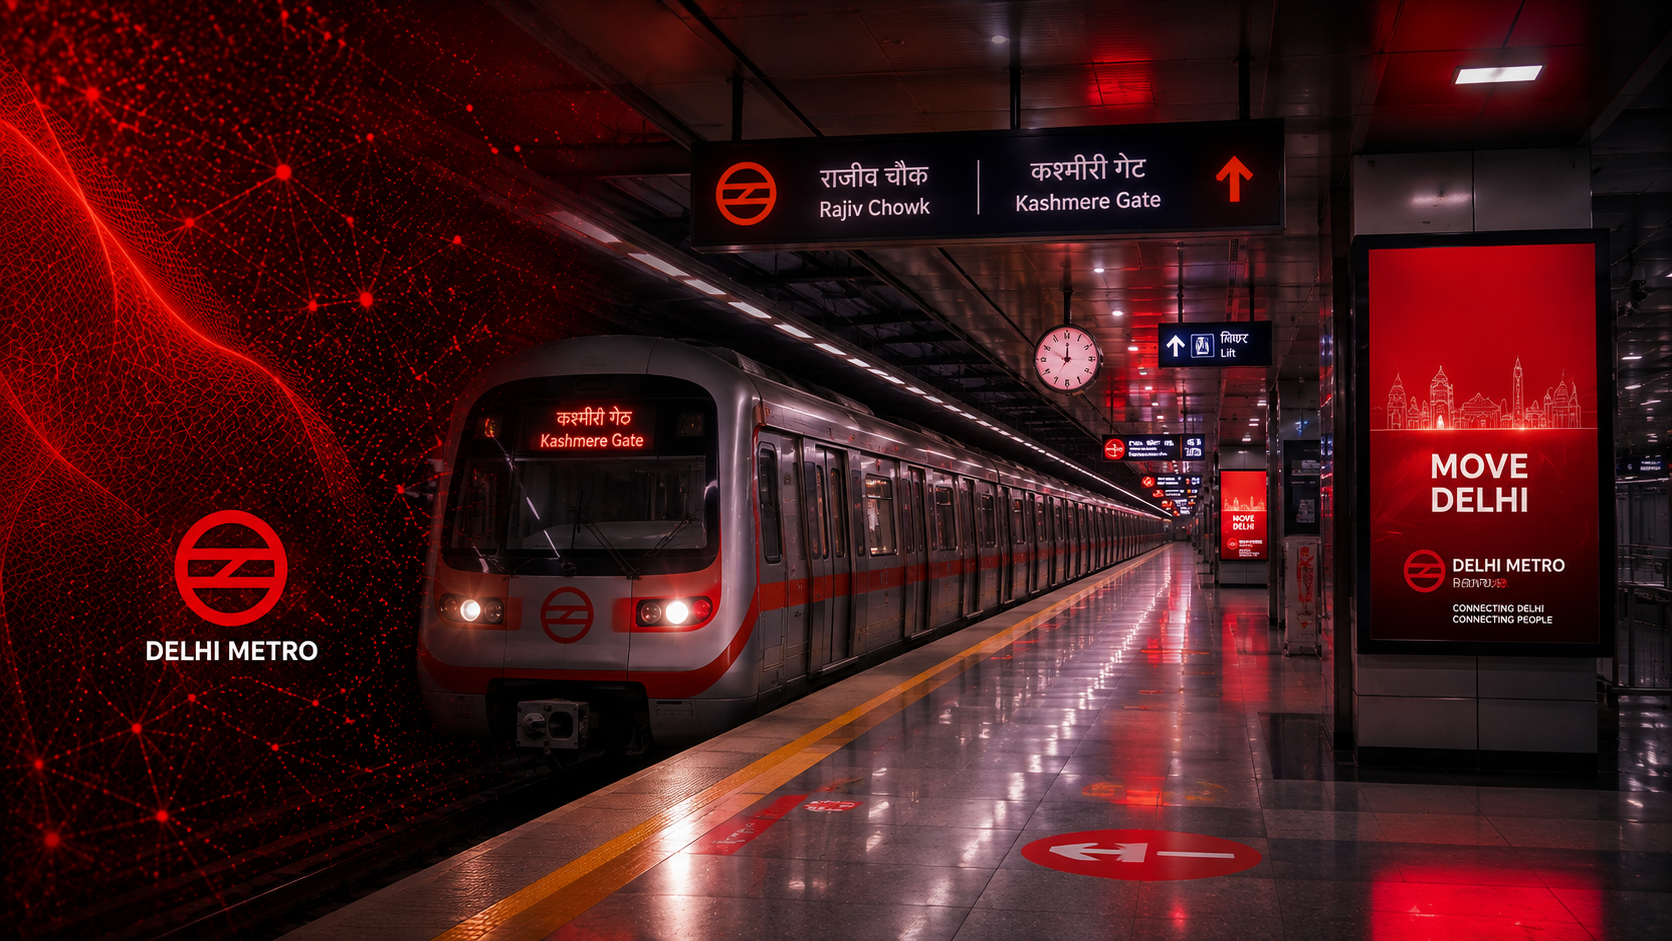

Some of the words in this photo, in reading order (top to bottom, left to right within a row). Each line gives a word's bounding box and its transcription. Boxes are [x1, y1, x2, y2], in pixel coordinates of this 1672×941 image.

[819, 161, 880, 188] राजीव
[883, 159, 930, 186] चौक
[1029, 153, 1109, 181] कश्मीरी
[1113, 152, 1147, 179] गेट
[820, 199, 864, 222] Rajiv
[868, 197, 931, 217] Chowk
[1016, 193, 1111, 212] Kashmere
[1116, 191, 1162, 209] Gate
[1220, 347, 1237, 358] Lift
[556, 406, 606, 427] कश्मीरी
[540, 433, 608, 448] Kashmere
[611, 432, 644, 447] Gate
[1431, 452, 1529, 480] MOVE
[1431, 486, 1528, 513] DELHI
[1452, 558, 1501, 573] DELHI
[1506, 558, 1566, 573] METRO
[1452, 603, 1515, 613] CONNECTING
[1517, 604, 1545, 613] DELHI
[1452, 614, 1515, 624] CONNECTING
[1516, 615, 1553, 625] PEOPLE
